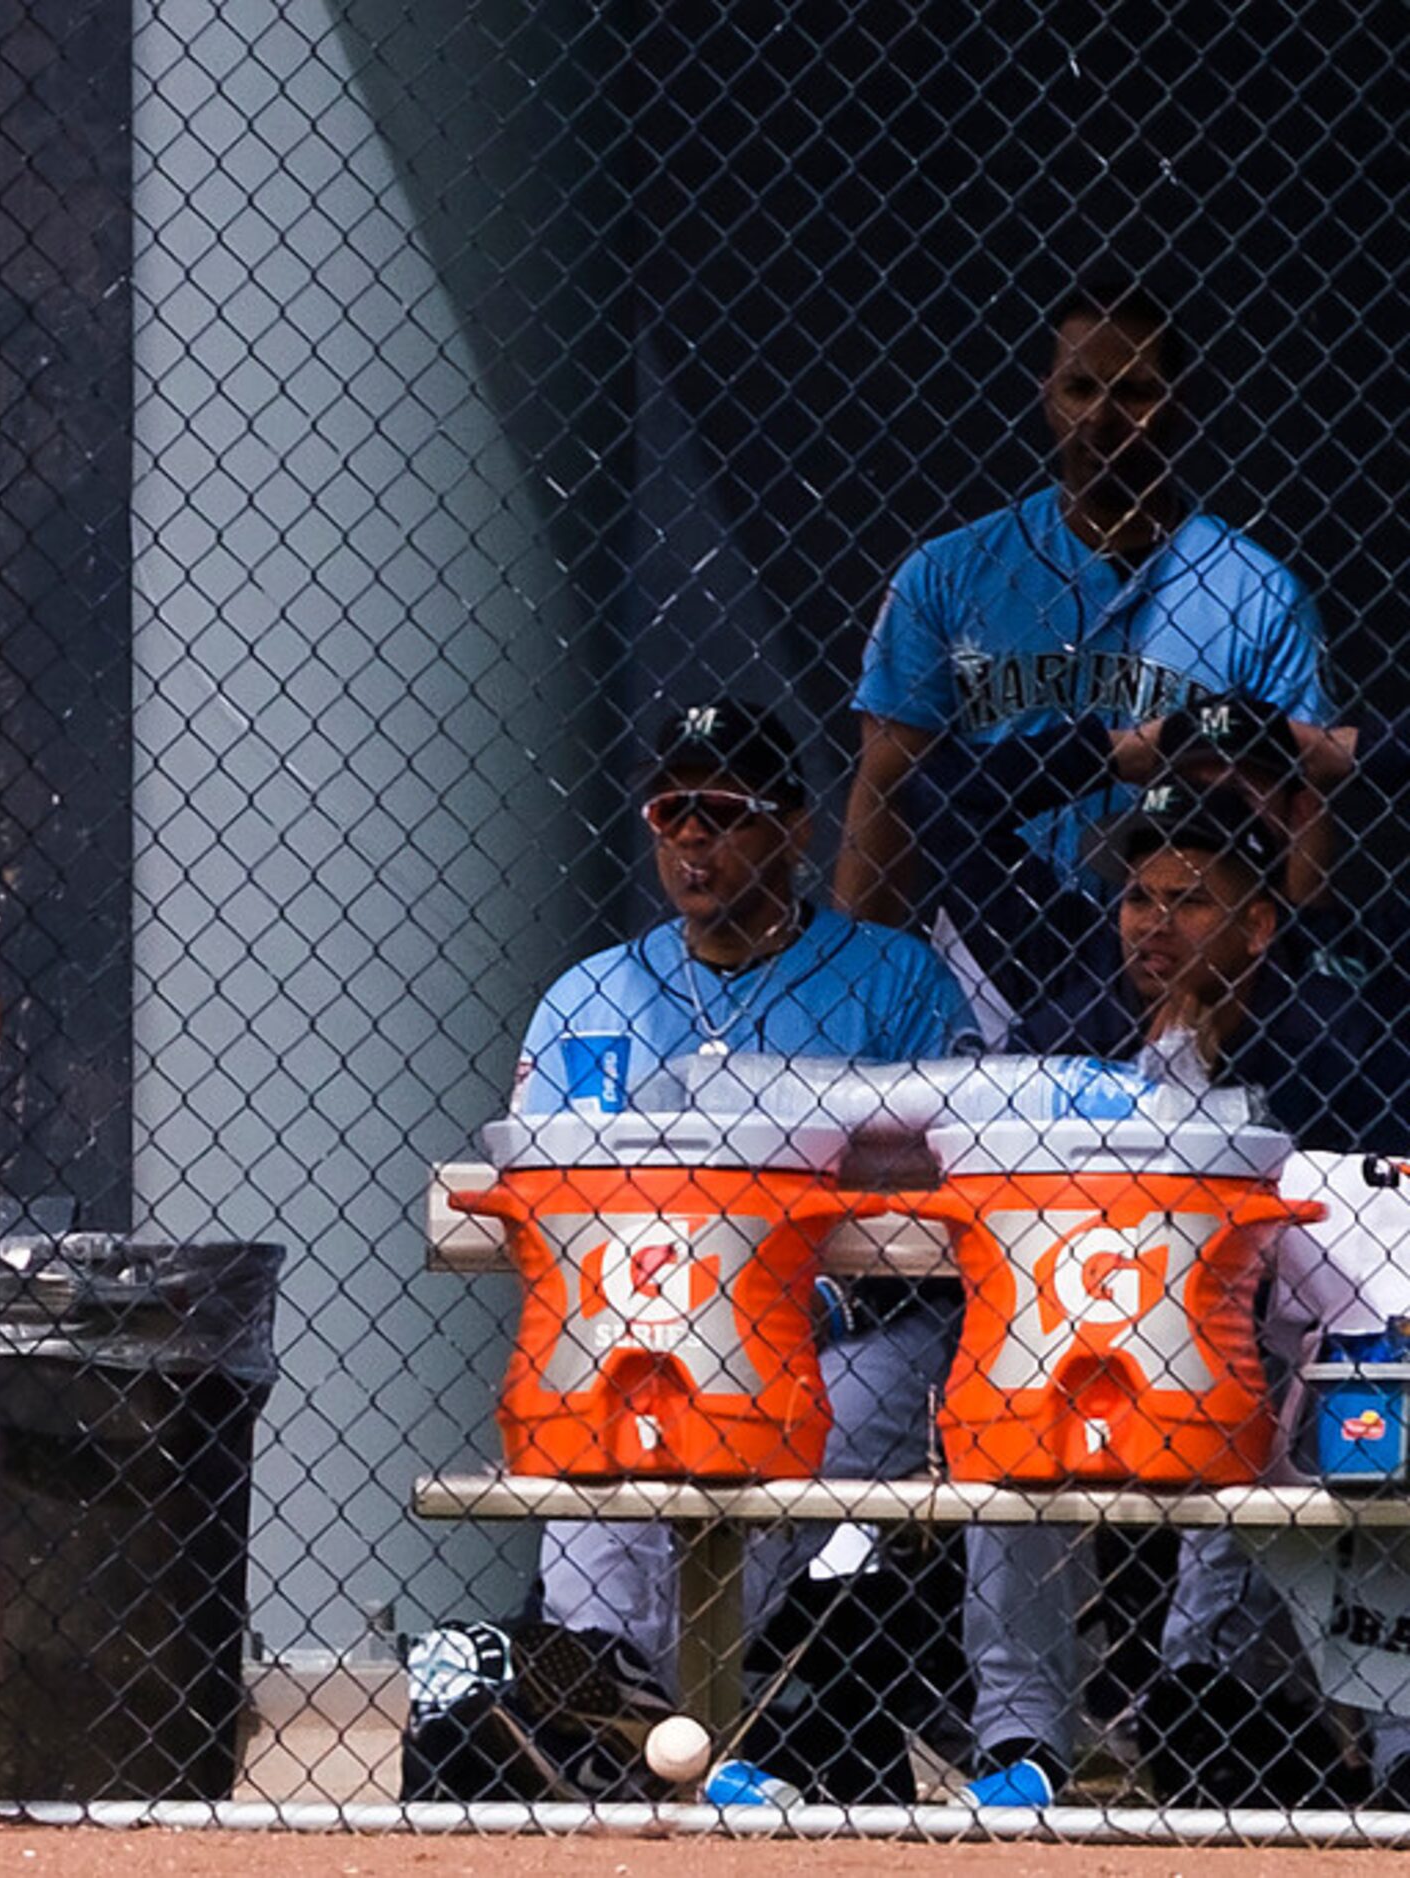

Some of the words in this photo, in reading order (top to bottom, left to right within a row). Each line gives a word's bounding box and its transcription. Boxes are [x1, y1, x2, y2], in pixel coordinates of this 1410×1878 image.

[950, 646, 1211, 731] MARINE
[685, 707, 717, 736] M
[1201, 705, 1230, 734] M
[1142, 786, 1172, 811] M
[602, 1215, 689, 1321] G
[1054, 1227, 1139, 1324] G
